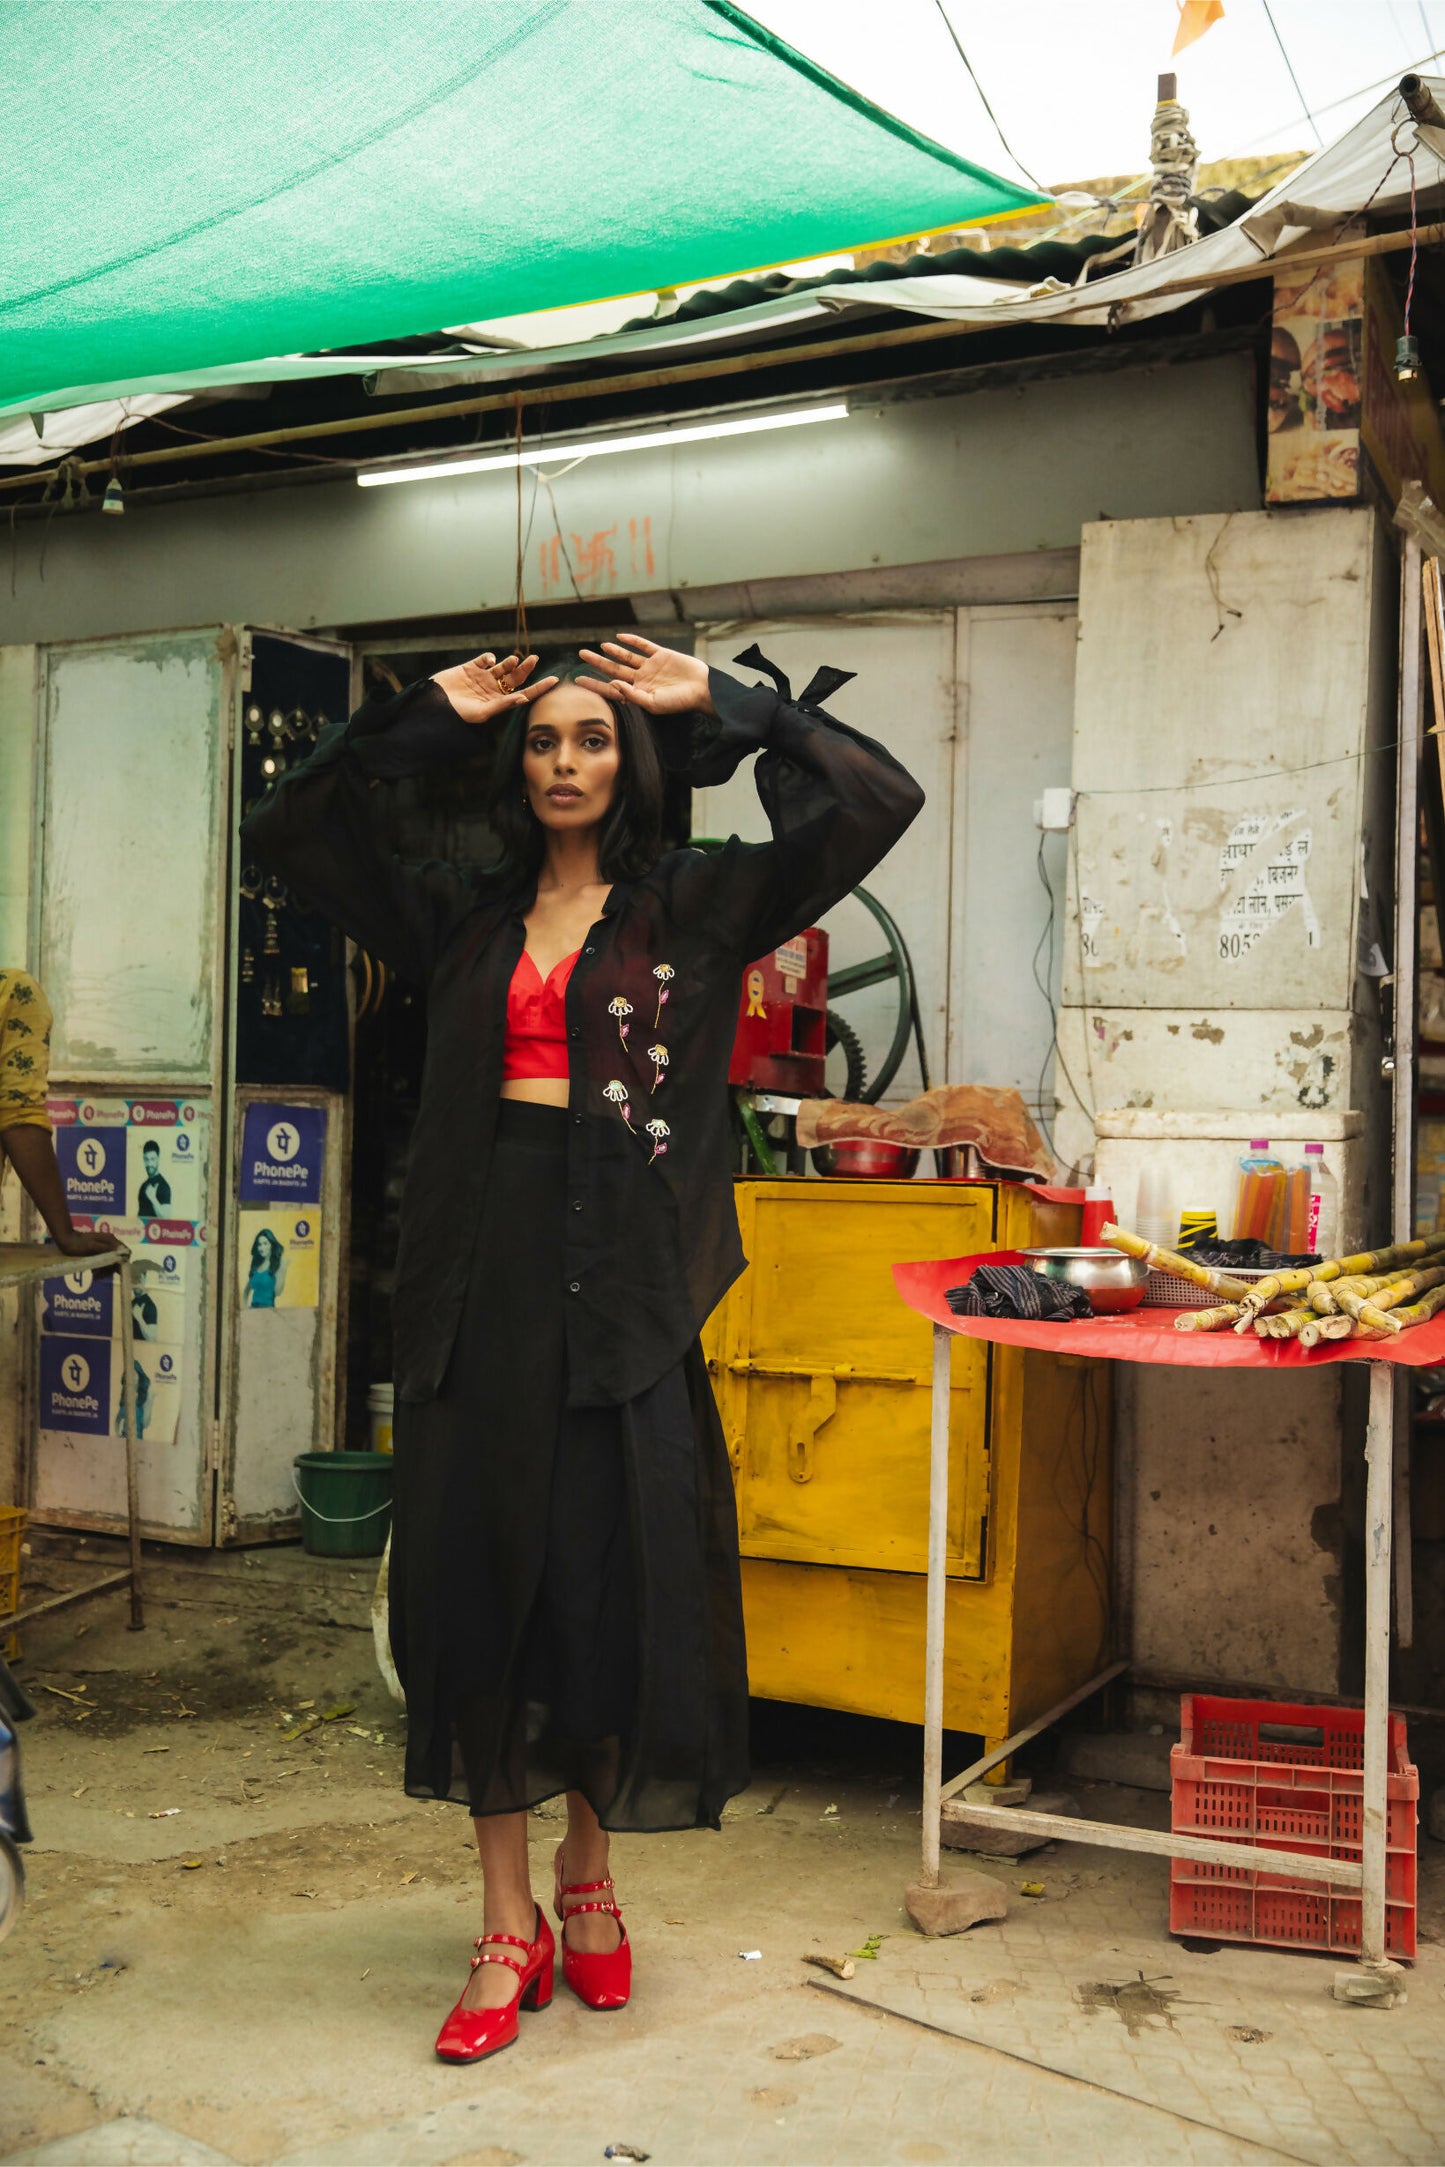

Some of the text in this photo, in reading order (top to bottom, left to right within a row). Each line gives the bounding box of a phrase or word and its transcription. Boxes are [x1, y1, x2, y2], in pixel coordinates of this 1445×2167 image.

[254, 1161, 309, 1179] PhonePe
[67, 1178, 115, 1194] PhonePe
[54, 1294, 102, 1312] PhonePe
[51, 1392, 99, 1411] PhonePe
